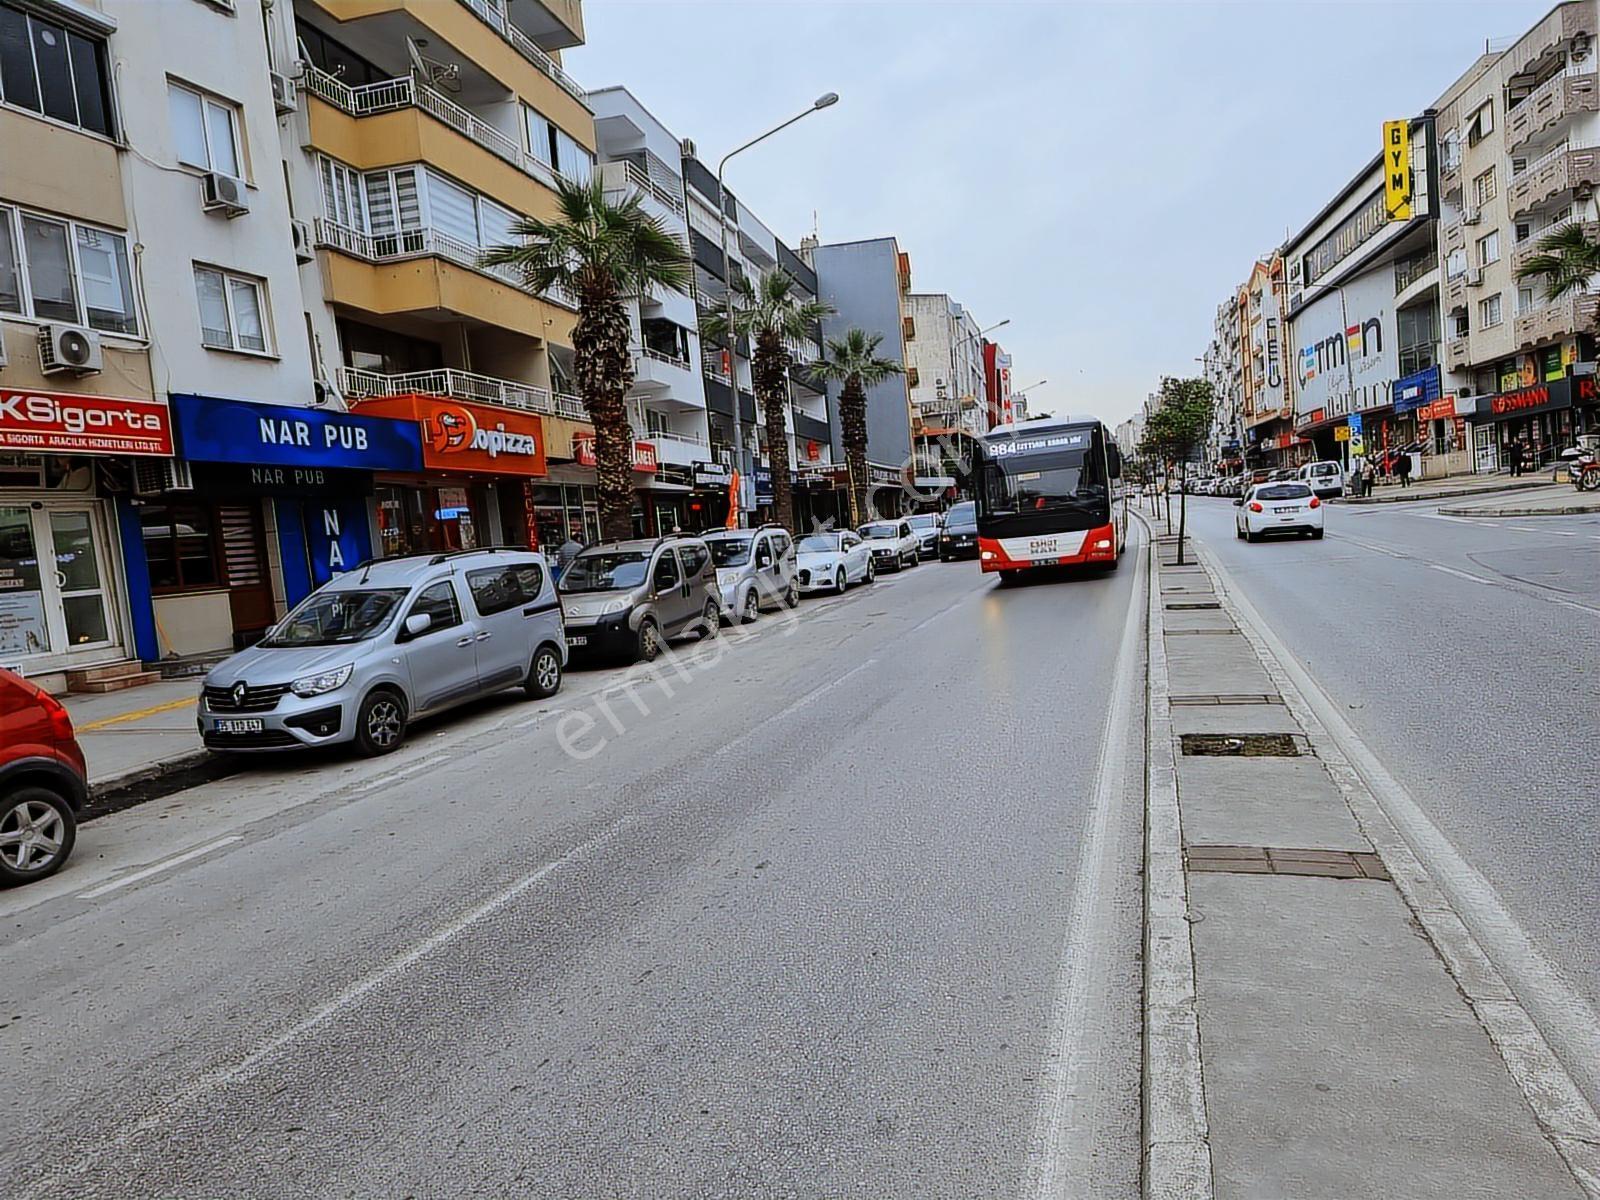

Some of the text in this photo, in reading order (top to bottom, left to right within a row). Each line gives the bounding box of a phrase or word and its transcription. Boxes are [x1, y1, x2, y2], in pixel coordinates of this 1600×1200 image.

[1391, 128, 1404, 191] GYM
[1491, 387, 1549, 414] ROSSMANN
[259, 418, 369, 450] NAR PUB
[251, 467, 325, 485] NAR PUB
